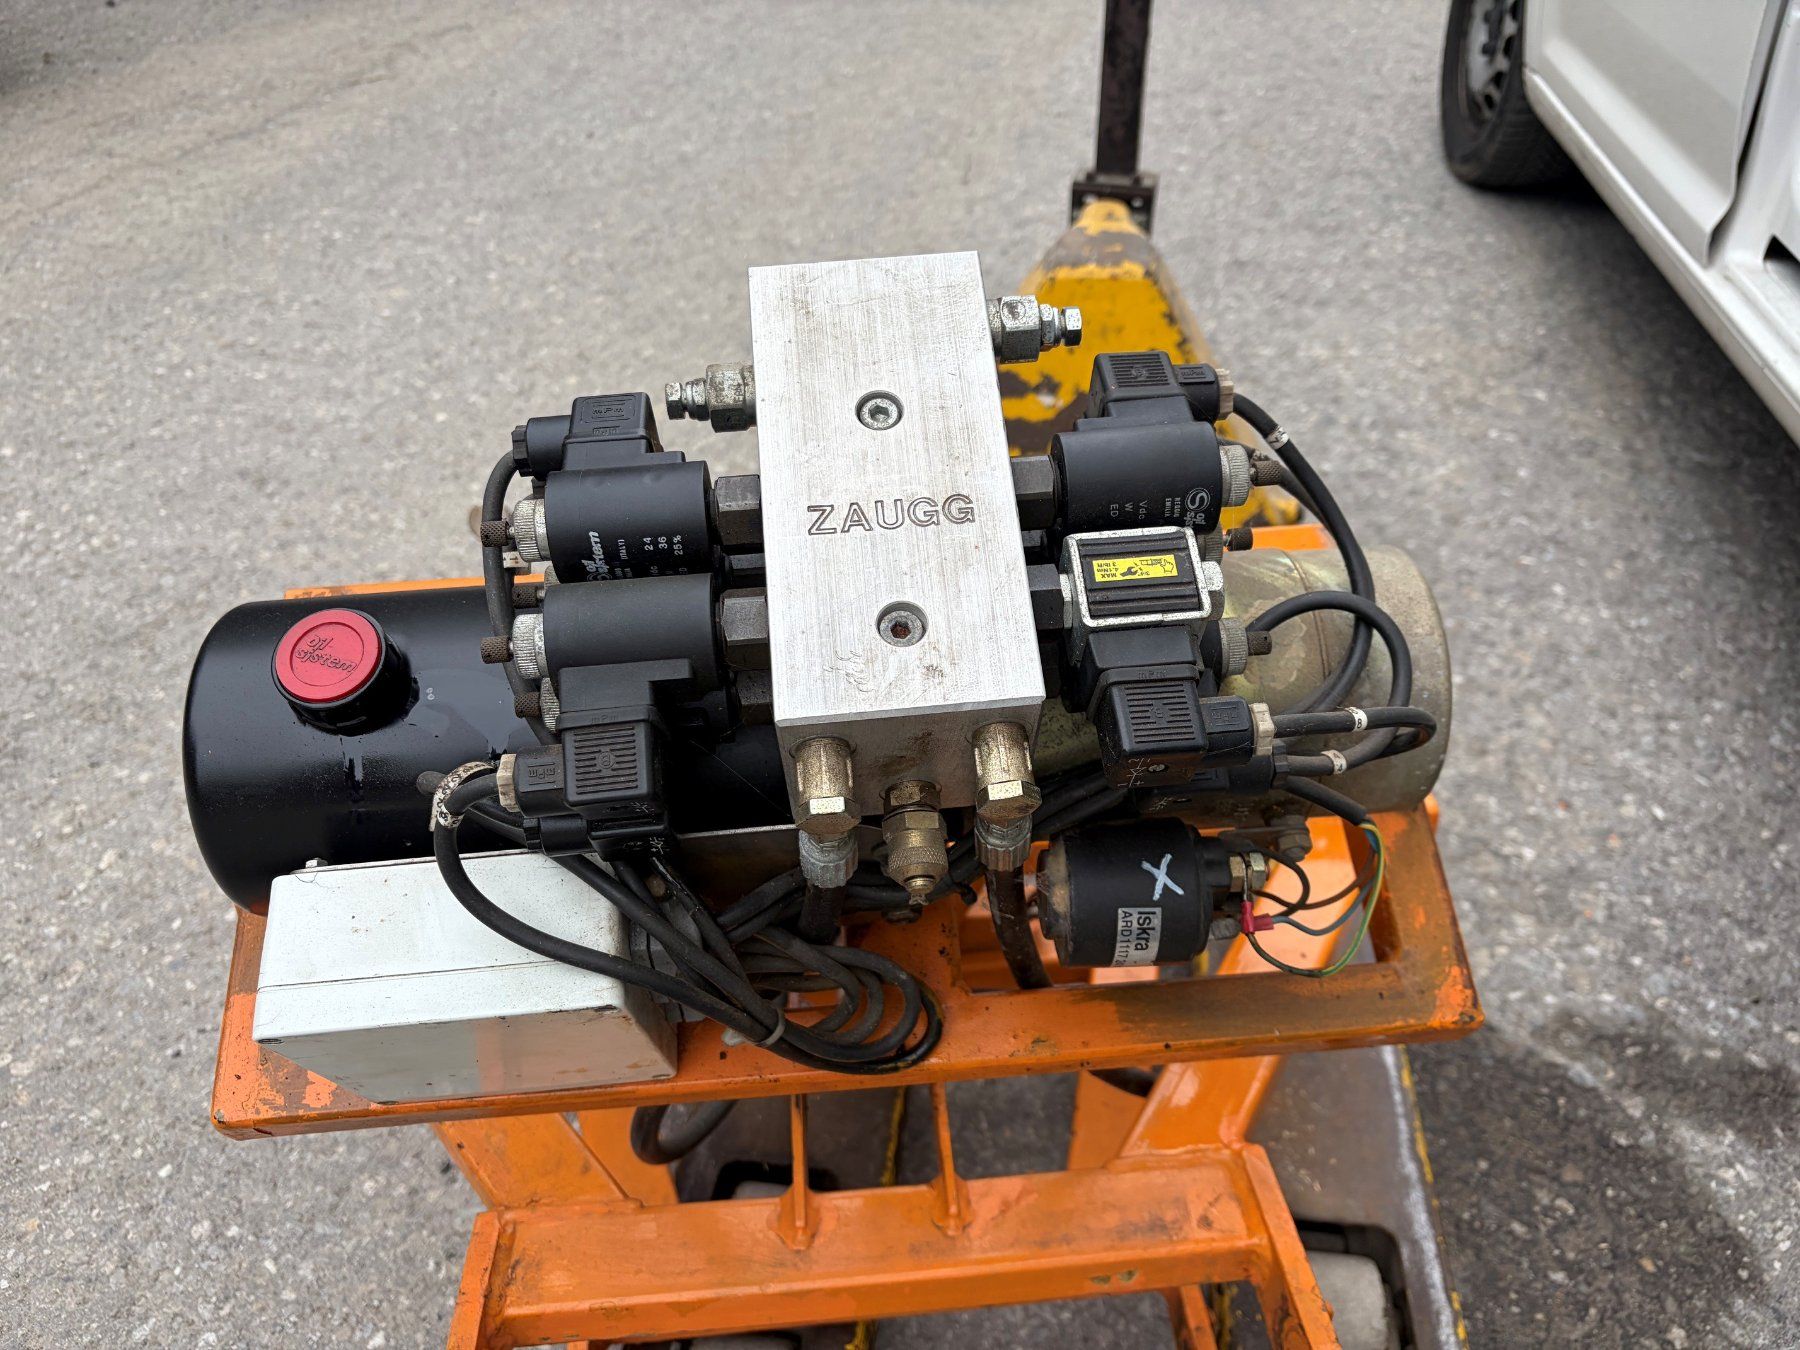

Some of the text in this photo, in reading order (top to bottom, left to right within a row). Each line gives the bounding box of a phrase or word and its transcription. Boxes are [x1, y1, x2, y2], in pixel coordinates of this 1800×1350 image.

[807, 493, 976, 536] ZAUGG
[1110, 503, 1119, 518] ED
[1124, 501, 1134, 512] W
[1138, 500, 1148, 520] Vdc
[643, 537, 654, 551] 24
[658, 536, 668, 549] 36
[673, 534, 684, 556] 25%
[1134, 910, 1157, 951] Iskra
